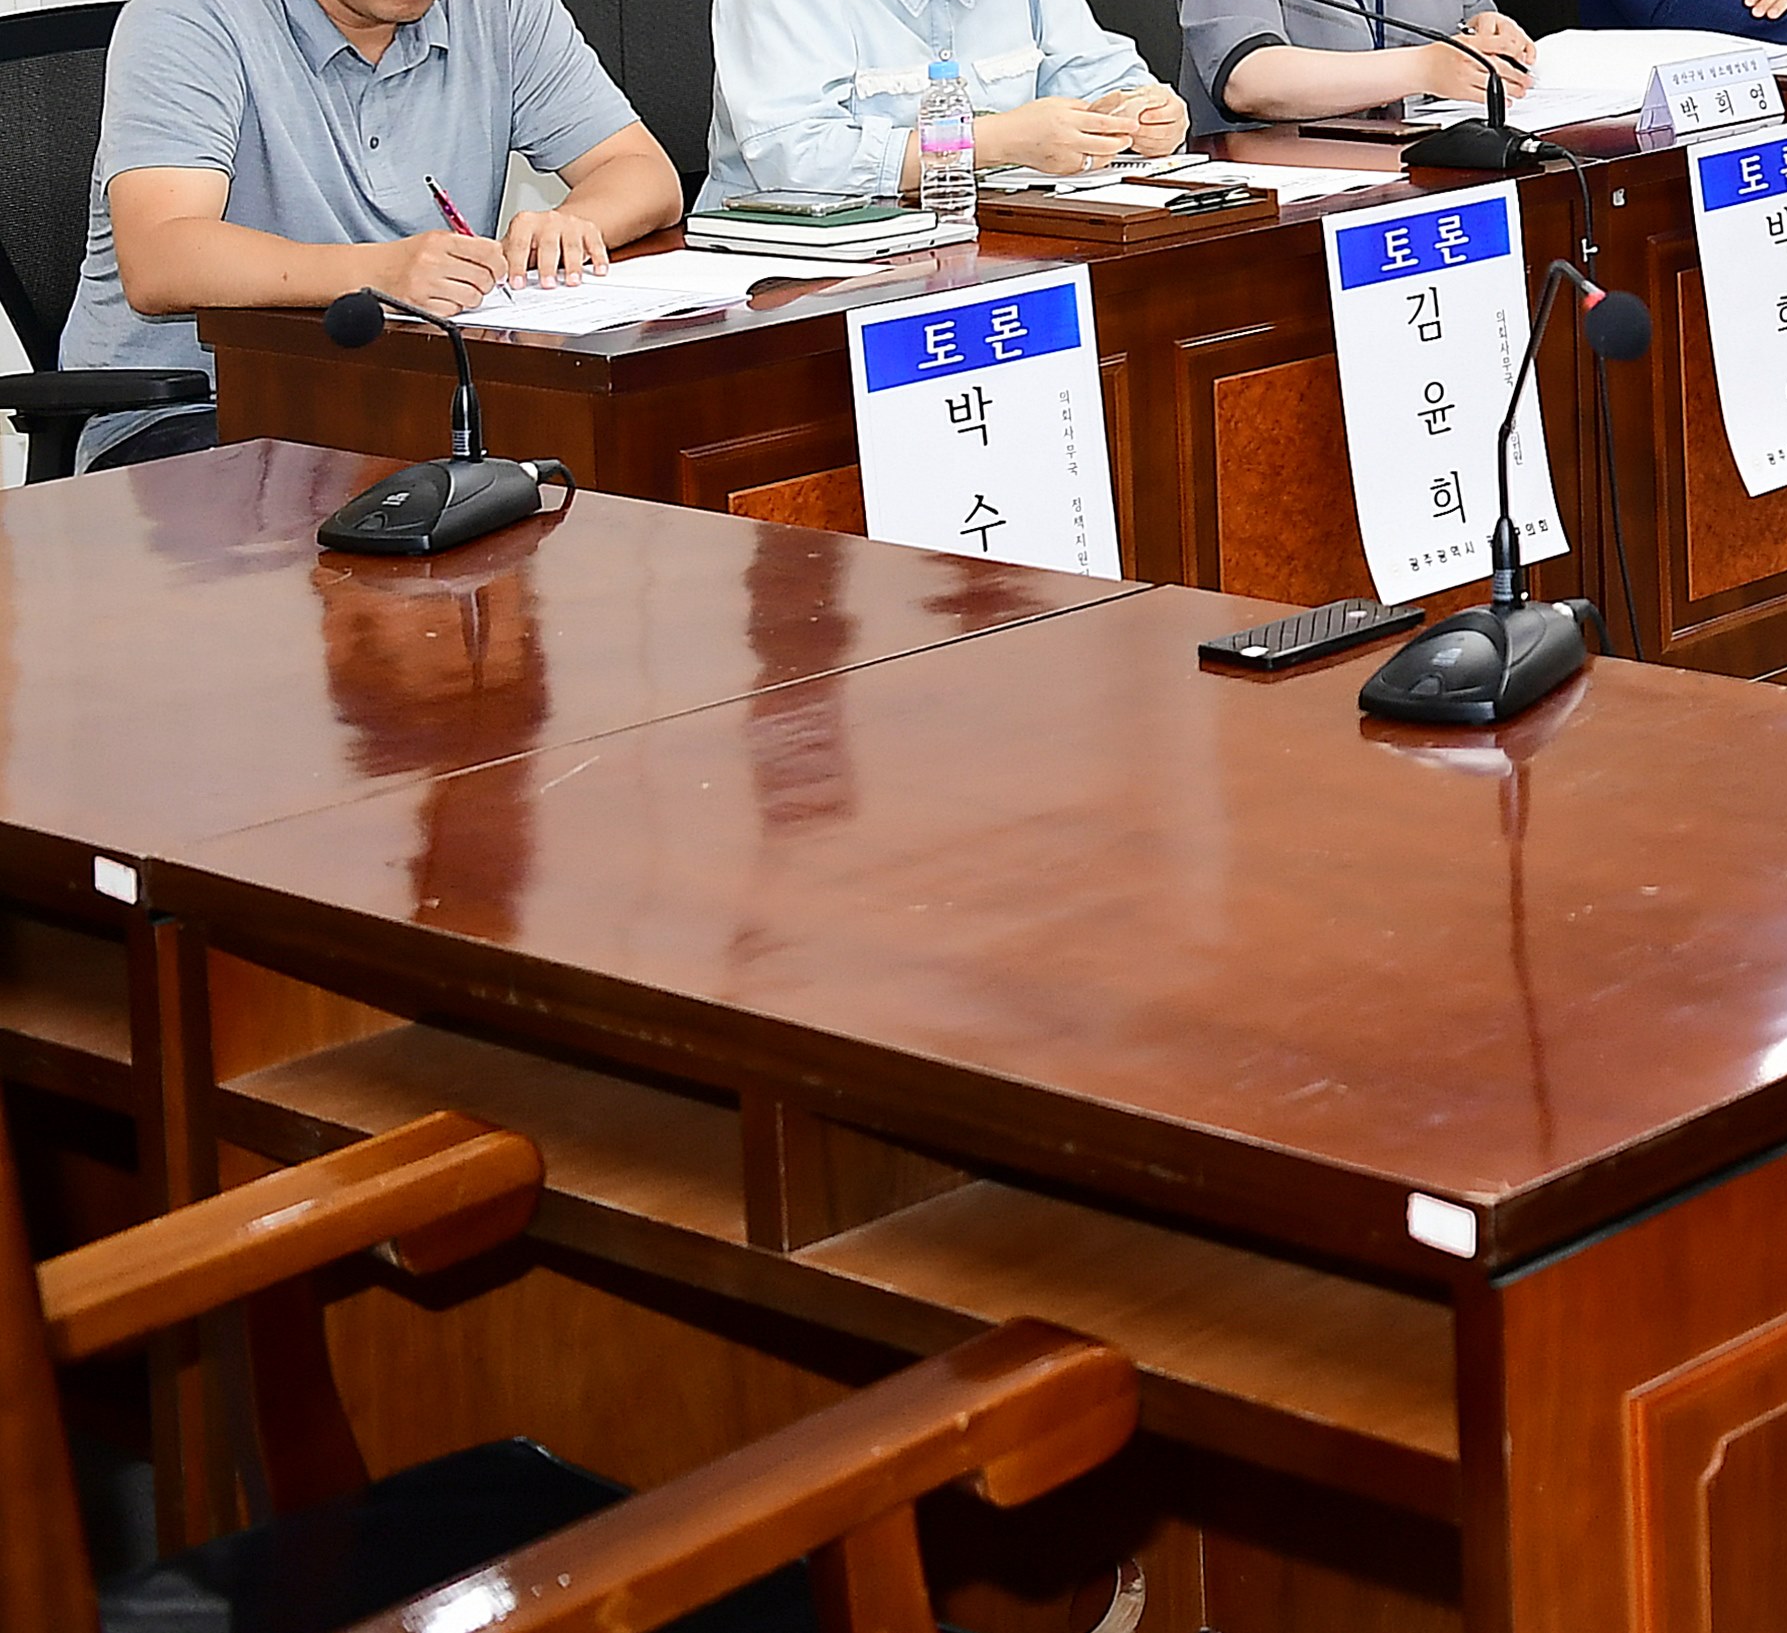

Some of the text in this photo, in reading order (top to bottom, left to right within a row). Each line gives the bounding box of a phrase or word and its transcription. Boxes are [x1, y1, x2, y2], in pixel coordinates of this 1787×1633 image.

[1680, 83, 1768, 123] 박희영
[1380, 214, 1471, 272] 토론
[917, 304, 1029, 370] 토론
[1495, 308, 1514, 388] 의회사무국
[1058, 389, 1079, 477] 의회사무국
[1405, 285, 1468, 524] 김윤희
[1408, 541, 1475, 572] 광주광역시
